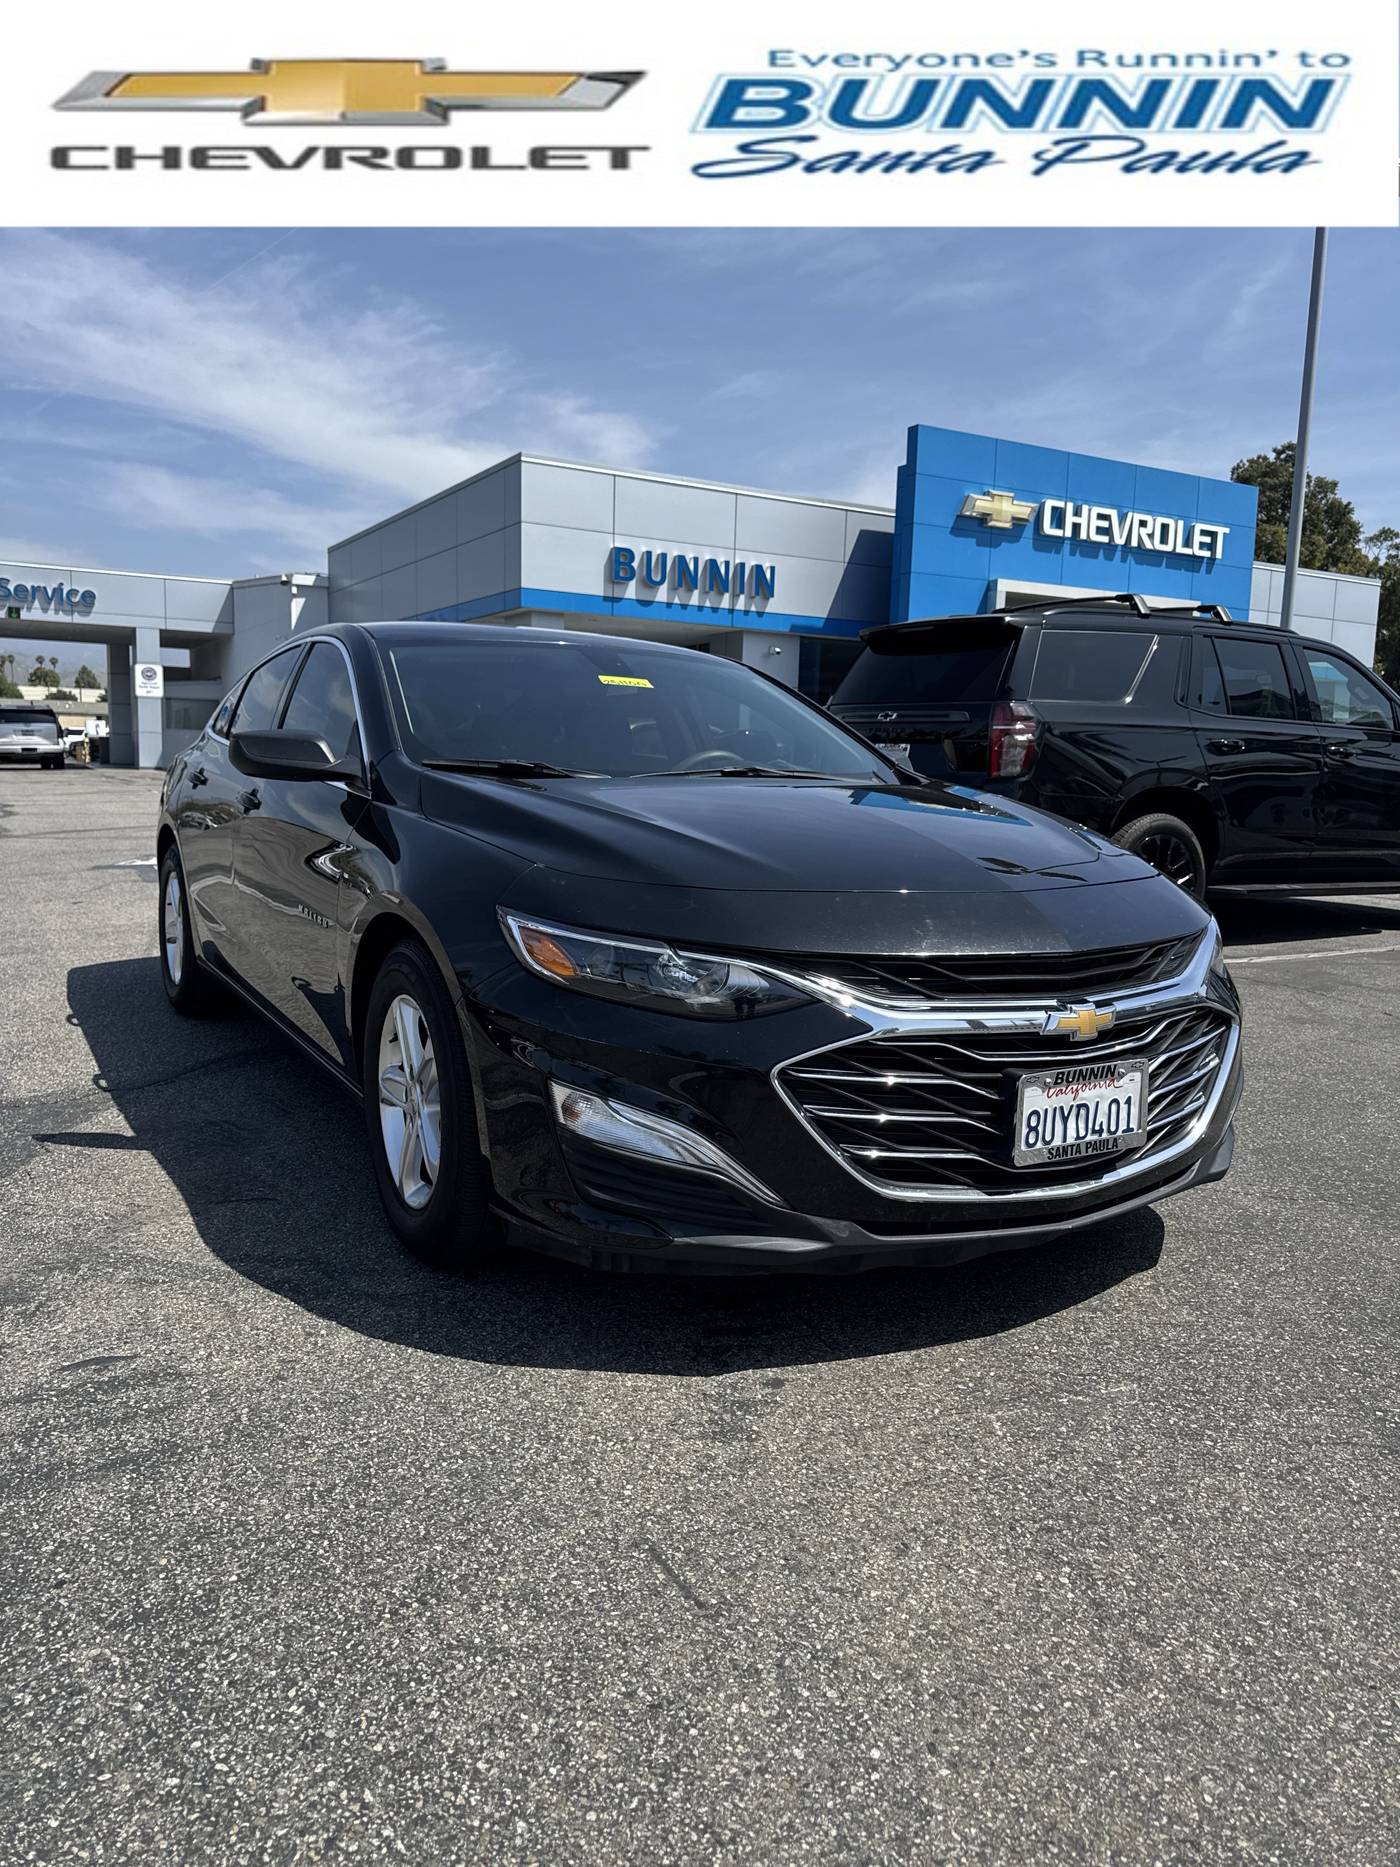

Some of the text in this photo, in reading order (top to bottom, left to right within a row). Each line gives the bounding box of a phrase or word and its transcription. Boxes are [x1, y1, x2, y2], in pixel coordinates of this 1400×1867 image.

[1042, 499, 1230, 560] CHEVROLET
[611, 546, 775, 598] BUNNIN
[0, 577, 97, 607] Service
[1046, 1076, 1123, 1101] California
[1053, 1064, 1118, 1086] BUNNIN
[1025, 1095, 1135, 1149] 8UYD401
[1047, 1138, 1119, 1161] SANTA PAULA
